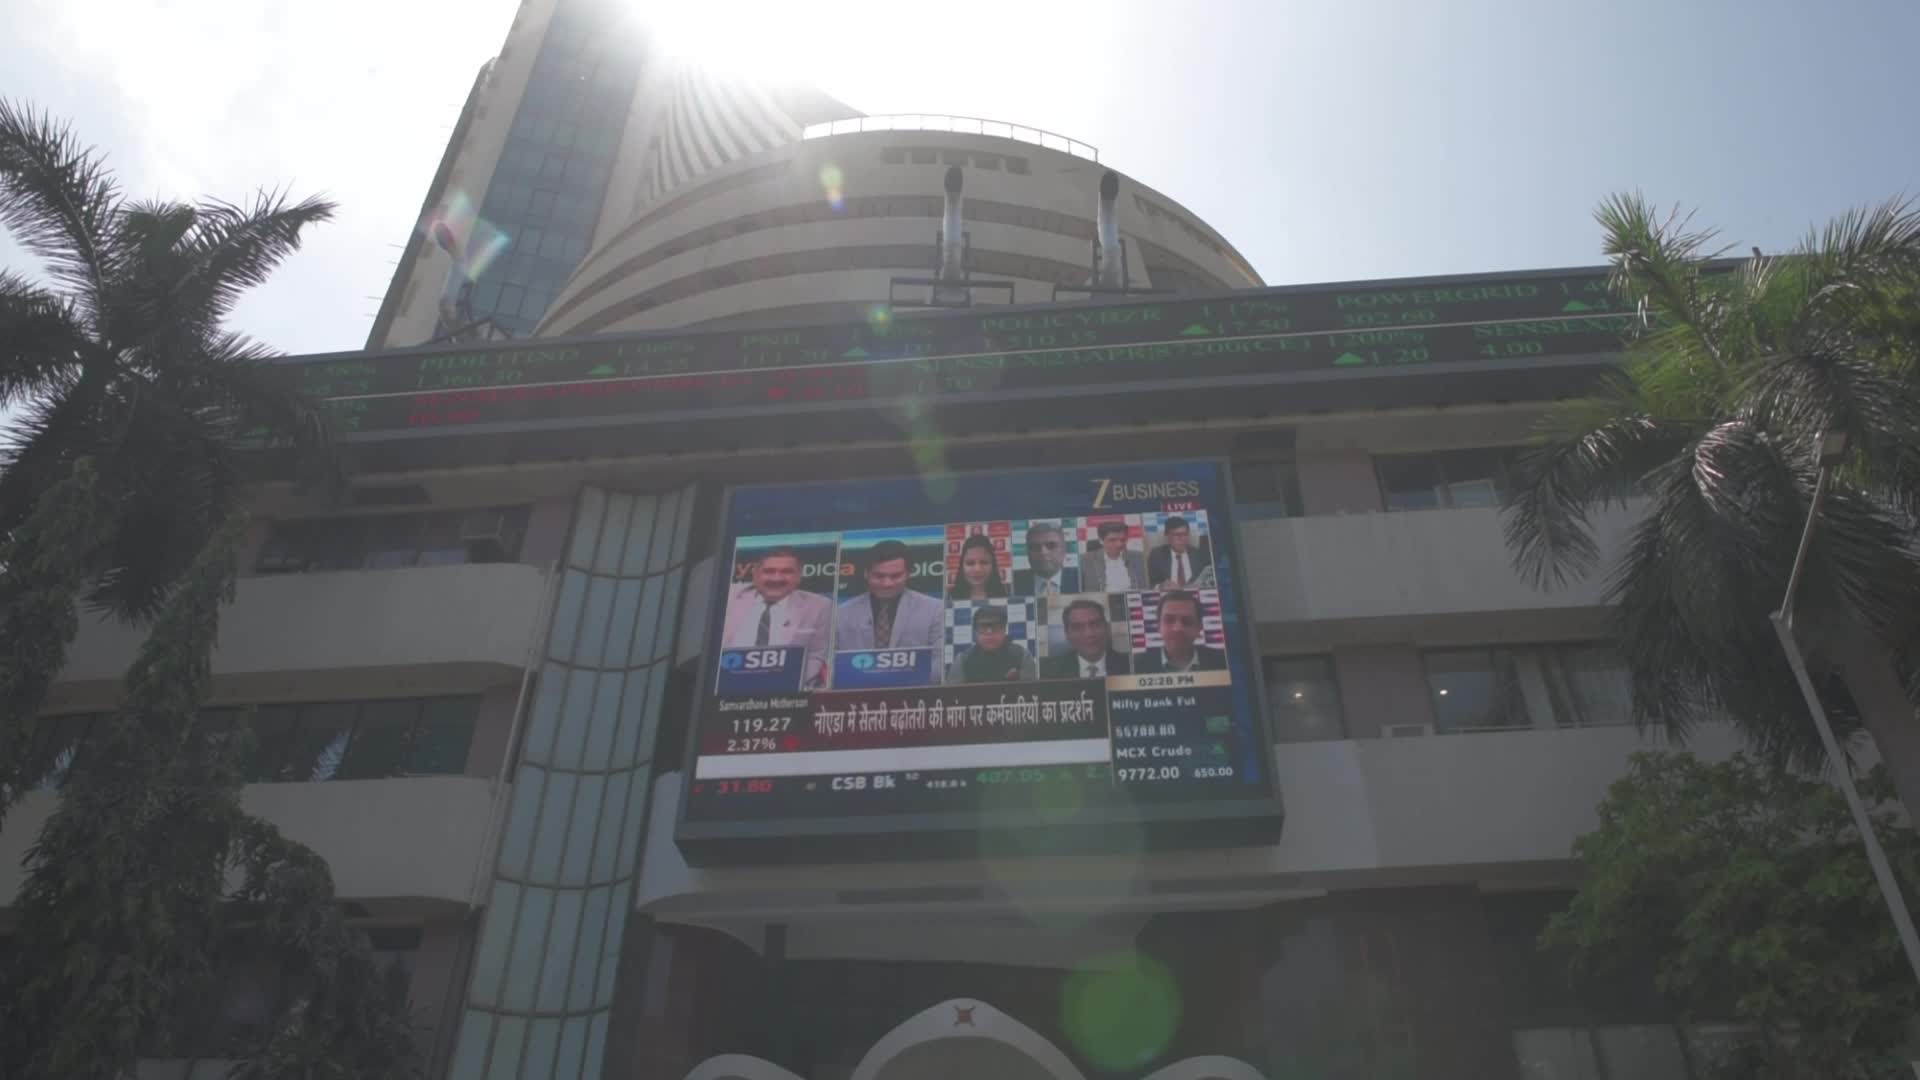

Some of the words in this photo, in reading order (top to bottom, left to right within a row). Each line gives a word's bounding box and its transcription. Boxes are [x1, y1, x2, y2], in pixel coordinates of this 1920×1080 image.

[1336, 282, 1539, 308] POWERGRID
[1343, 310, 1438, 328] 302.60
[1480, 341, 1544, 357] 4.00
[1112, 480, 1201, 502] BUSINESS
[1166, 501, 1193, 512] LIVE
[744, 650, 787, 669] SBI
[876, 651, 917, 667] SBI
[1138, 676, 1173, 687] 02:28
[1177, 674, 1195, 686] PM
[1112, 697, 1141, 712] Nifty
[1144, 696, 1173, 709] Bank
[1176, 695, 1196, 707] Fut
[814, 705, 844, 735] नोएडा
[848, 705, 858, 733] में
[859, 701, 887, 733] सैलरी
[928, 698, 944, 729] की
[946, 699, 968, 729] मांग
[969, 704, 983, 727] पर
[986, 694, 1039, 727] कर्मचारियों
[1041, 700, 1057, 723] का
[1059, 690, 1095, 723] प्रदर्शन
[733, 717, 792, 735] 119.27
[727, 736, 777, 752] 2.37%
[1116, 746, 1147, 760] MCX
[1151, 744, 1192, 758] Crude
[831, 775, 867, 791] CSB
[872, 773, 897, 790] Bk
[1118, 766, 1180, 783] 9772.00
[1194, 766, 1233, 780] 650.00
